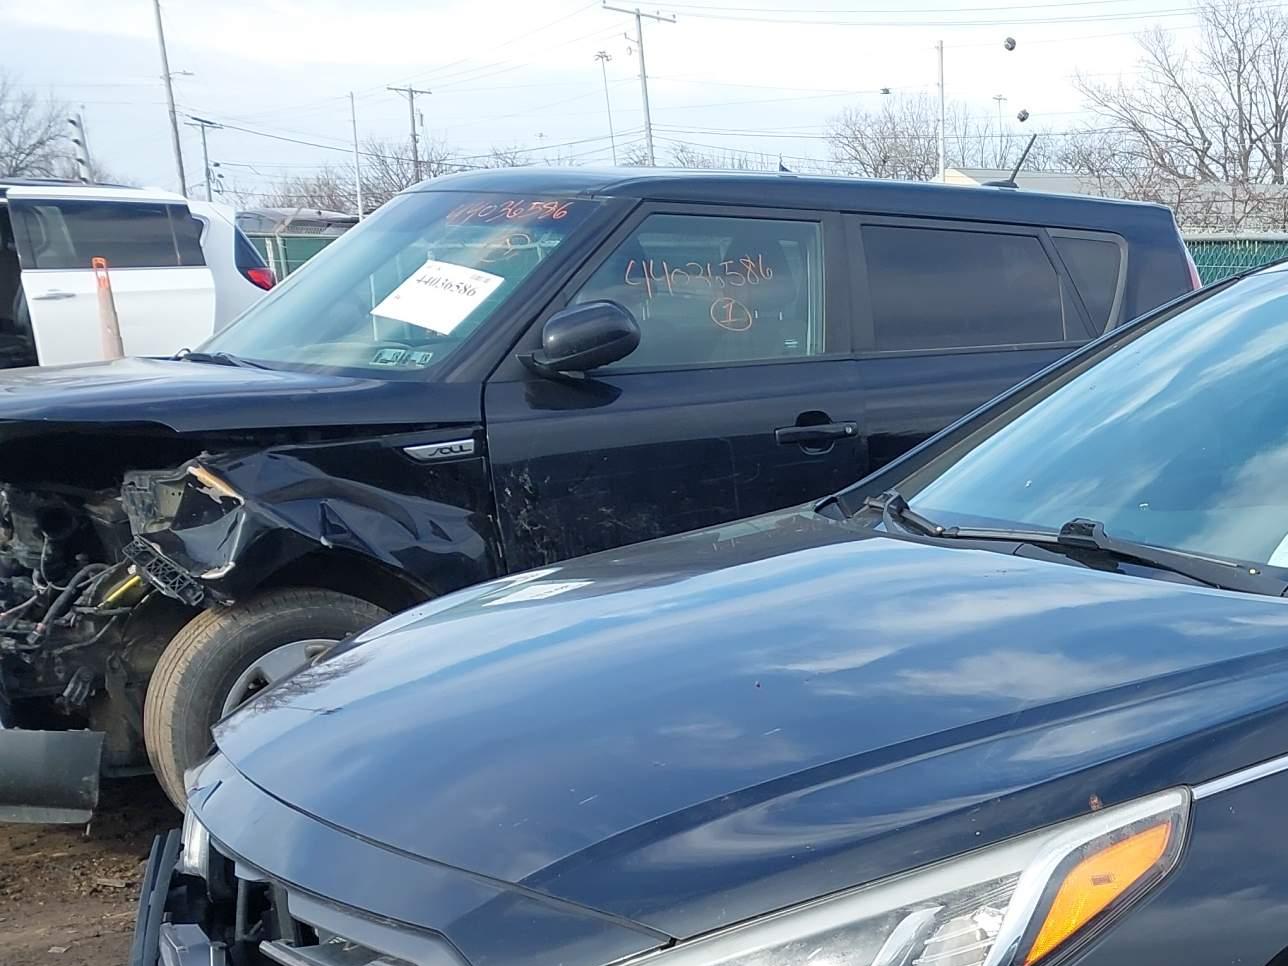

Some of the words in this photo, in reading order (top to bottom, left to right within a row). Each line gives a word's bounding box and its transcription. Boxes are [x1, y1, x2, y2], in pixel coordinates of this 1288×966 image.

[415, 274, 478, 297] 44036586
[625, 254, 773, 298] 44036586
[428, 445, 472, 457] SOUL
